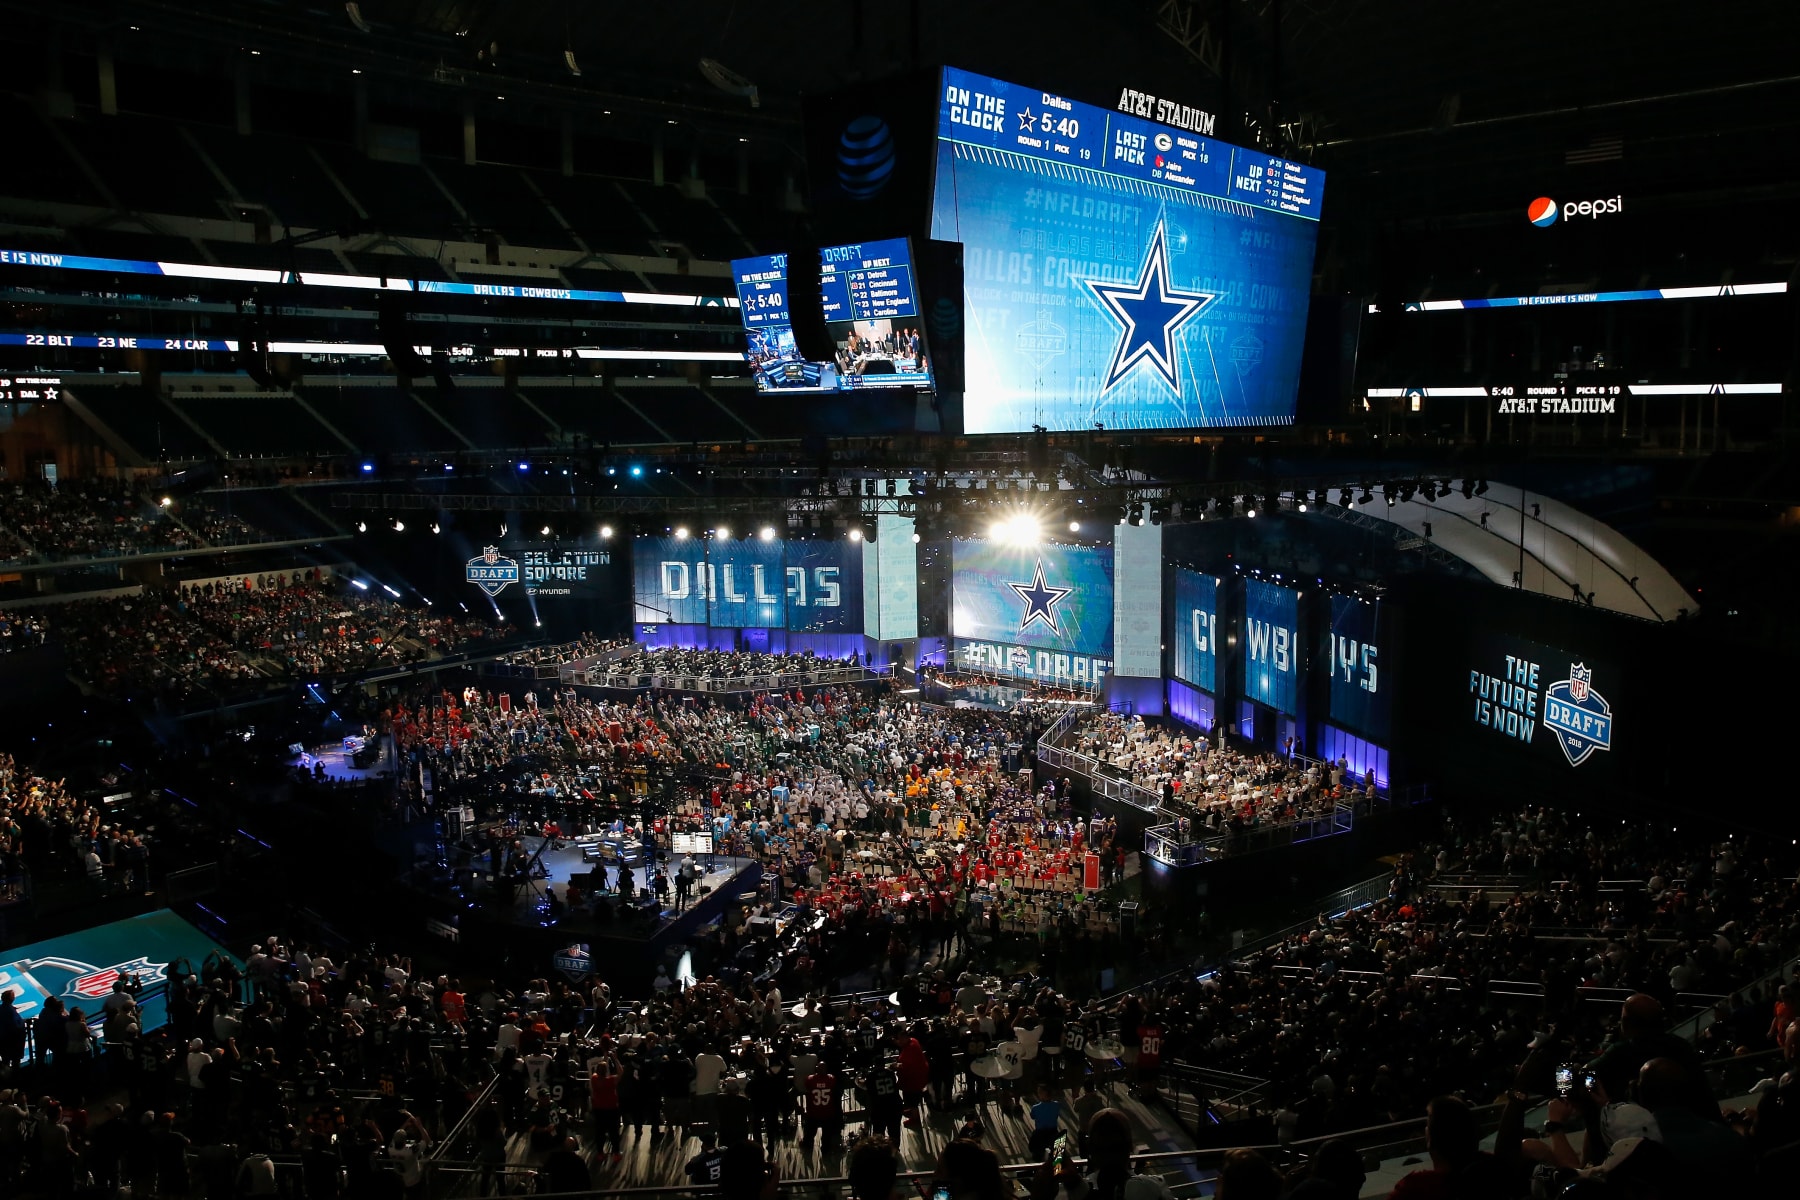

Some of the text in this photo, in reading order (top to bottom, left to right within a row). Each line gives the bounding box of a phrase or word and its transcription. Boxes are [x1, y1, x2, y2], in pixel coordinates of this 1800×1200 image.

[947, 86, 1006, 116] ON THE
[1042, 93, 1072, 111] Dallas
[1118, 87, 1215, 136] AT&T STADIUM
[950, 106, 1004, 133] CLOCK
[1041, 112, 1079, 139] 5:40
[1115, 129, 1147, 150] LAST
[1177, 137, 1205, 151] ROUND 1
[1017, 135, 1091, 160] ROUND 1 PICK 19
[1114, 145, 1145, 165] PICK
[1182, 150, 1209, 164] PICK 18
[1152, 169, 1195, 185] DB Alexander
[1249, 165, 1263, 179] UP
[1274, 170, 1280, 178] 21
[1235, 175, 1262, 193] NEXT
[1024, 187, 1142, 226] #NFLDRAFT
[1563, 195, 1623, 221] pepsi
[13, 252, 27, 264] IS
[30, 253, 63, 267] NOW
[824, 245, 862, 262] DRAFT
[770, 254, 788, 269] 20
[862, 258, 890, 268] UP NEXT
[968, 247, 1033, 285] ALLAS
[762, 270, 782, 279] CLOCK
[856, 270, 887, 280] 20 Detroit
[869, 279, 898, 288] Cincinnati
[473, 284, 571, 299] DALLAS COWBOYS
[860, 289, 898, 299] 22 Baltimore
[1011, 290, 1024, 302] ON
[1024, 291, 1040, 304] THE
[1041, 292, 1066, 306] CLOCK
[1534, 296, 1566, 304] FUTURE
[1568, 295, 1576, 303] IS
[1578, 294, 1598, 303] NOW
[758, 293, 782, 308] 5:40
[885, 297, 910, 307] England
[780, 312, 789, 320] 19
[873, 308, 898, 316] Carolina
[26, 334, 74, 347] 22 BLT
[98, 337, 137, 349] 23 NE
[165, 339, 209, 351] 24 CAR
[1019, 335, 1063, 349] DRAFT
[493, 348, 520, 356] ROUND
[523, 349, 528, 357] 1
[562, 349, 572, 357] 19
[0, 379, 11, 387] 19
[20, 390, 39, 399] DAL
[1491, 387, 1514, 396] 5:40
[1527, 387, 1557, 395] ROUND
[1560, 387, 1566, 395] 1
[1608, 386, 1620, 394] 19
[1499, 398, 1616, 413] AT&T STADIUM
[470, 569, 514, 578] DRAFT
[660, 561, 841, 607] DALLAS
[1505, 655, 1540, 689] THE
[1469, 670, 1538, 717] FUTURE
[1571, 679, 1588, 697] NFL
[1474, 698, 1535, 744] IS NOW
[1549, 703, 1606, 738] DRAFT
[1567, 737, 1582, 749] 2018
[862, 1035, 874, 1048] 10
[1066, 1031, 1084, 1051] 20
[1141, 1037, 1160, 1055] 80
[379, 1080, 394, 1096] 38
[552, 1085, 564, 1101] 9
[875, 1077, 895, 1096] 52
[811, 1089, 831, 1106] 35
